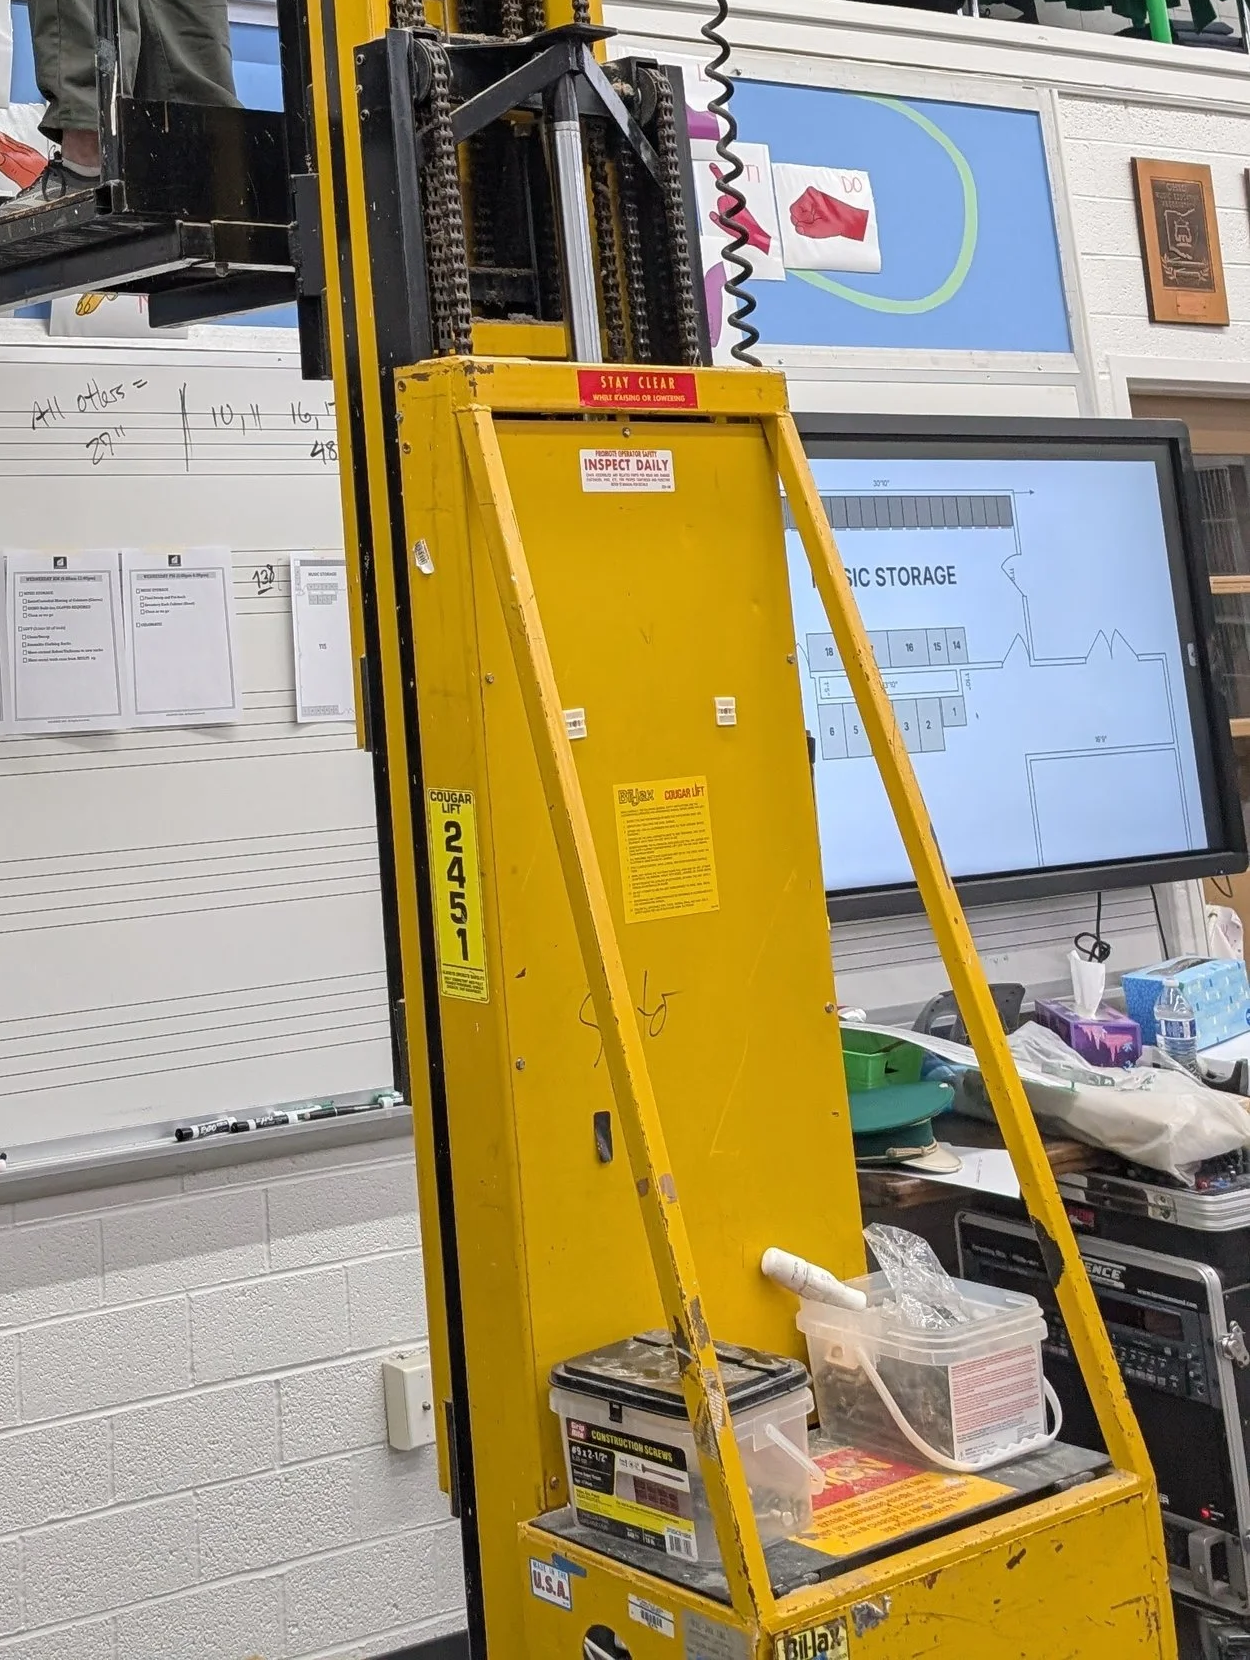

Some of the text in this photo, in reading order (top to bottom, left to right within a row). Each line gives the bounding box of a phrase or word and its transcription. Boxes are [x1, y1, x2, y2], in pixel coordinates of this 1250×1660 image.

[842, 174, 863, 195] DO
[600, 376, 676, 390] STAY CLEAR
[615, 394, 640, 402] RAISING
[31, 396, 65, 430] All
[584, 459, 669, 471] INSPECT DAILY
[875, 565, 958, 587] STORAGE
[825, 641, 961, 657] 18 16 15 14
[829, 707, 956, 736] 6 5 3 2 1
[430, 791, 472, 805] COUGAR
[664, 787, 691, 800] COUGAR
[692, 782, 705, 797] LIFT
[441, 803, 461, 814] LIFT
[591, 1430, 673, 1462] CONSTRUCTION SCREWS
[533, 1570, 569, 1601] U.S.A.
